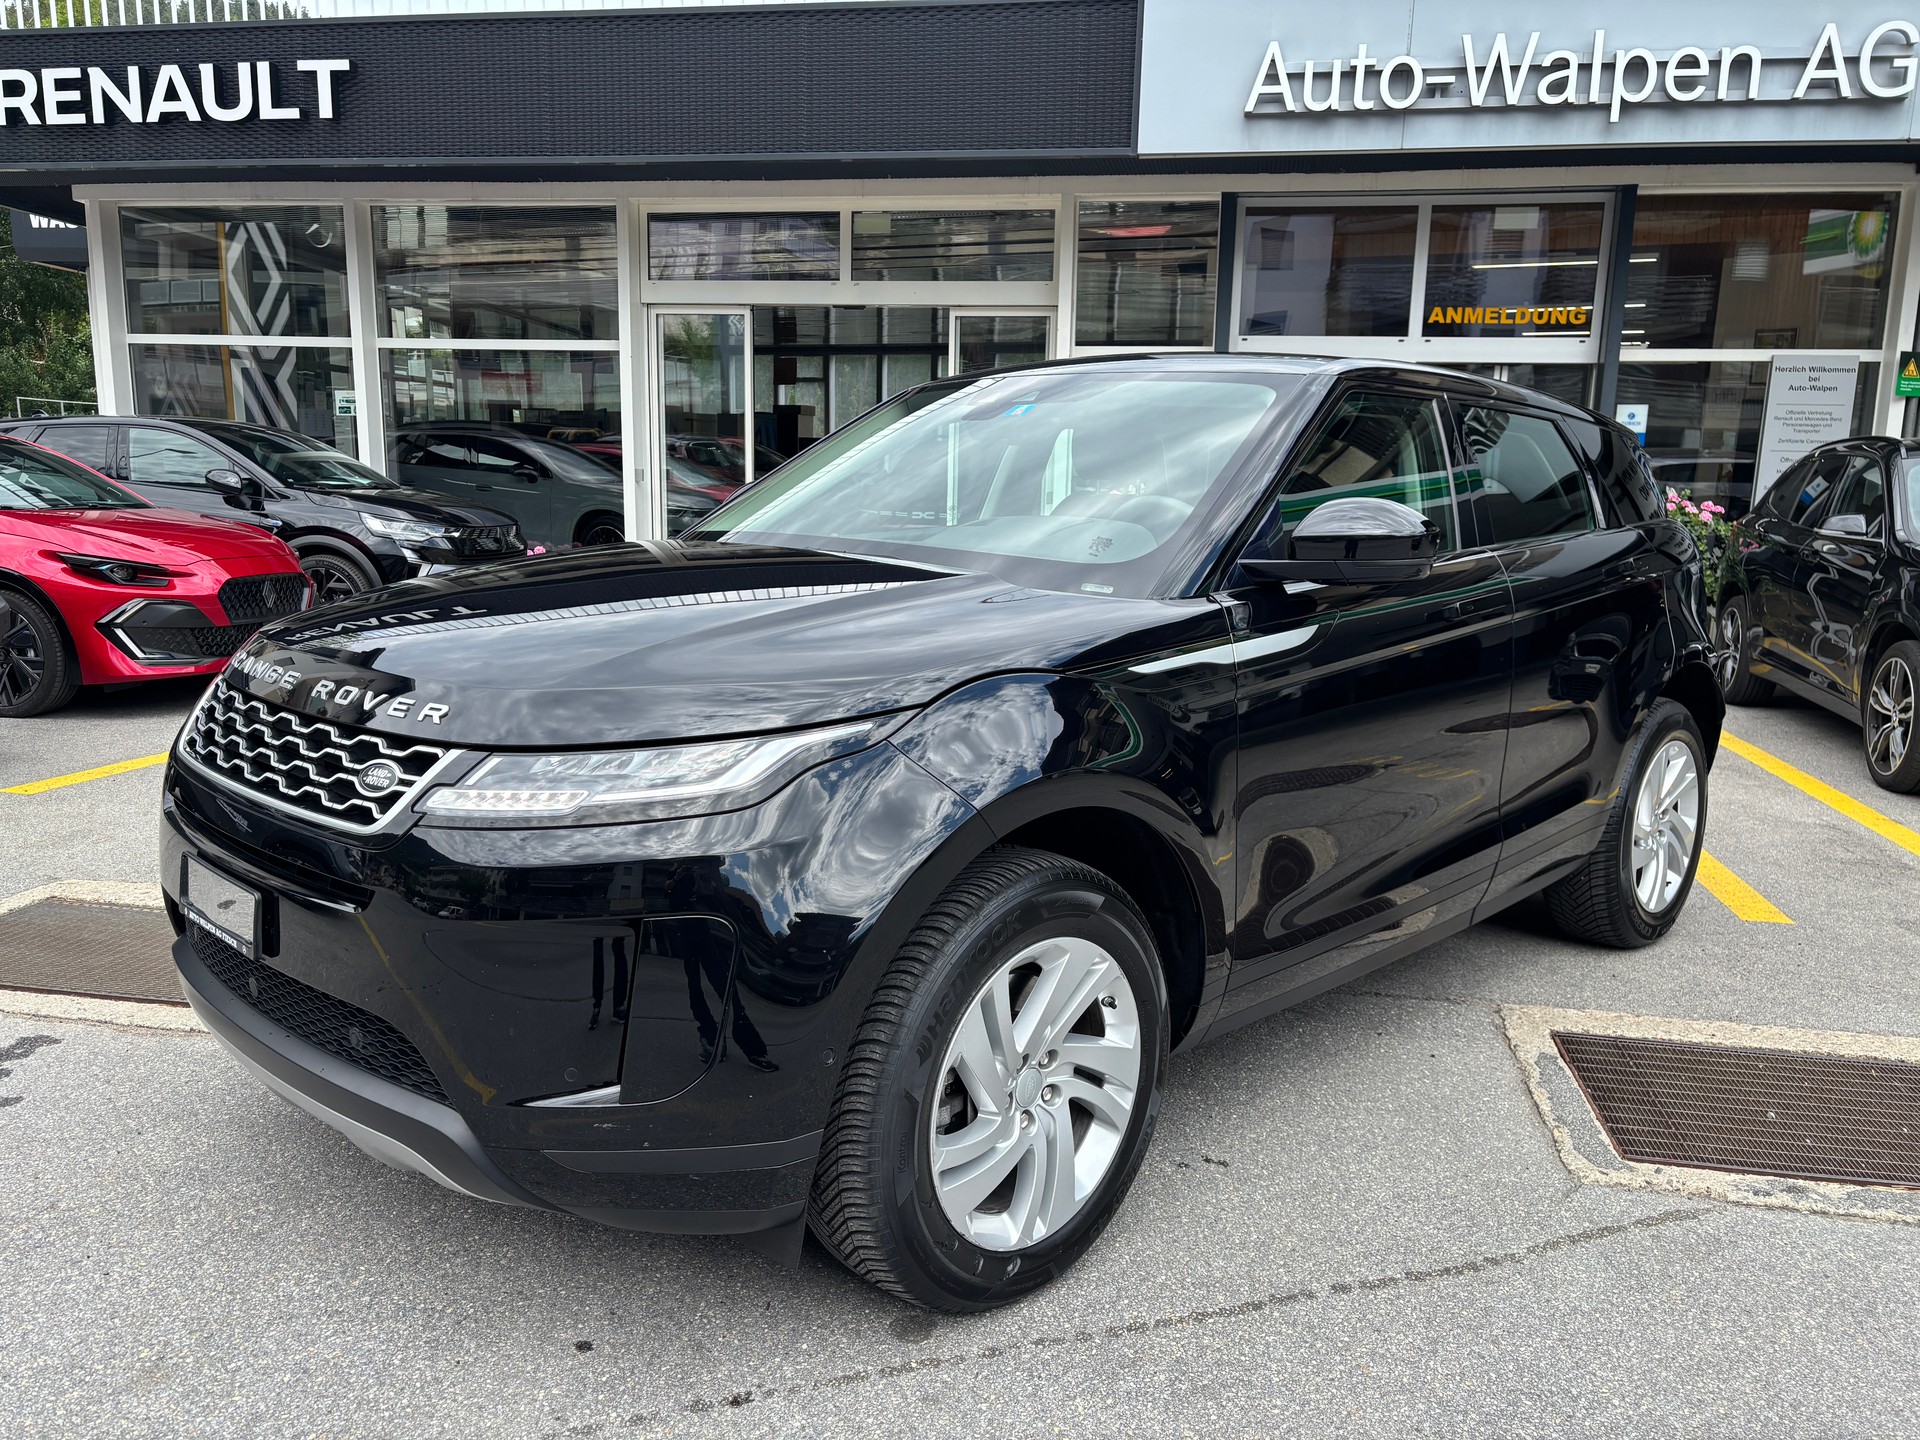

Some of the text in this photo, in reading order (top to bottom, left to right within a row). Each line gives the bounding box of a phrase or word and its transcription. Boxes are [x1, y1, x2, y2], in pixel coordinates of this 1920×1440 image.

[1243, 19, 1920, 123] Auto-Walpen AG
[0, 59, 350, 126] RENAULT
[1427, 306, 1587, 325] ANMELDUNG
[1808, 366, 1857, 374] Willkommen
[1788, 384, 1838, 393] Auto-Walpen
[231, 650, 451, 726] RANGE ROVER
[367, 767, 389, 778] LAND
[364, 775, 390, 788] ROVER
